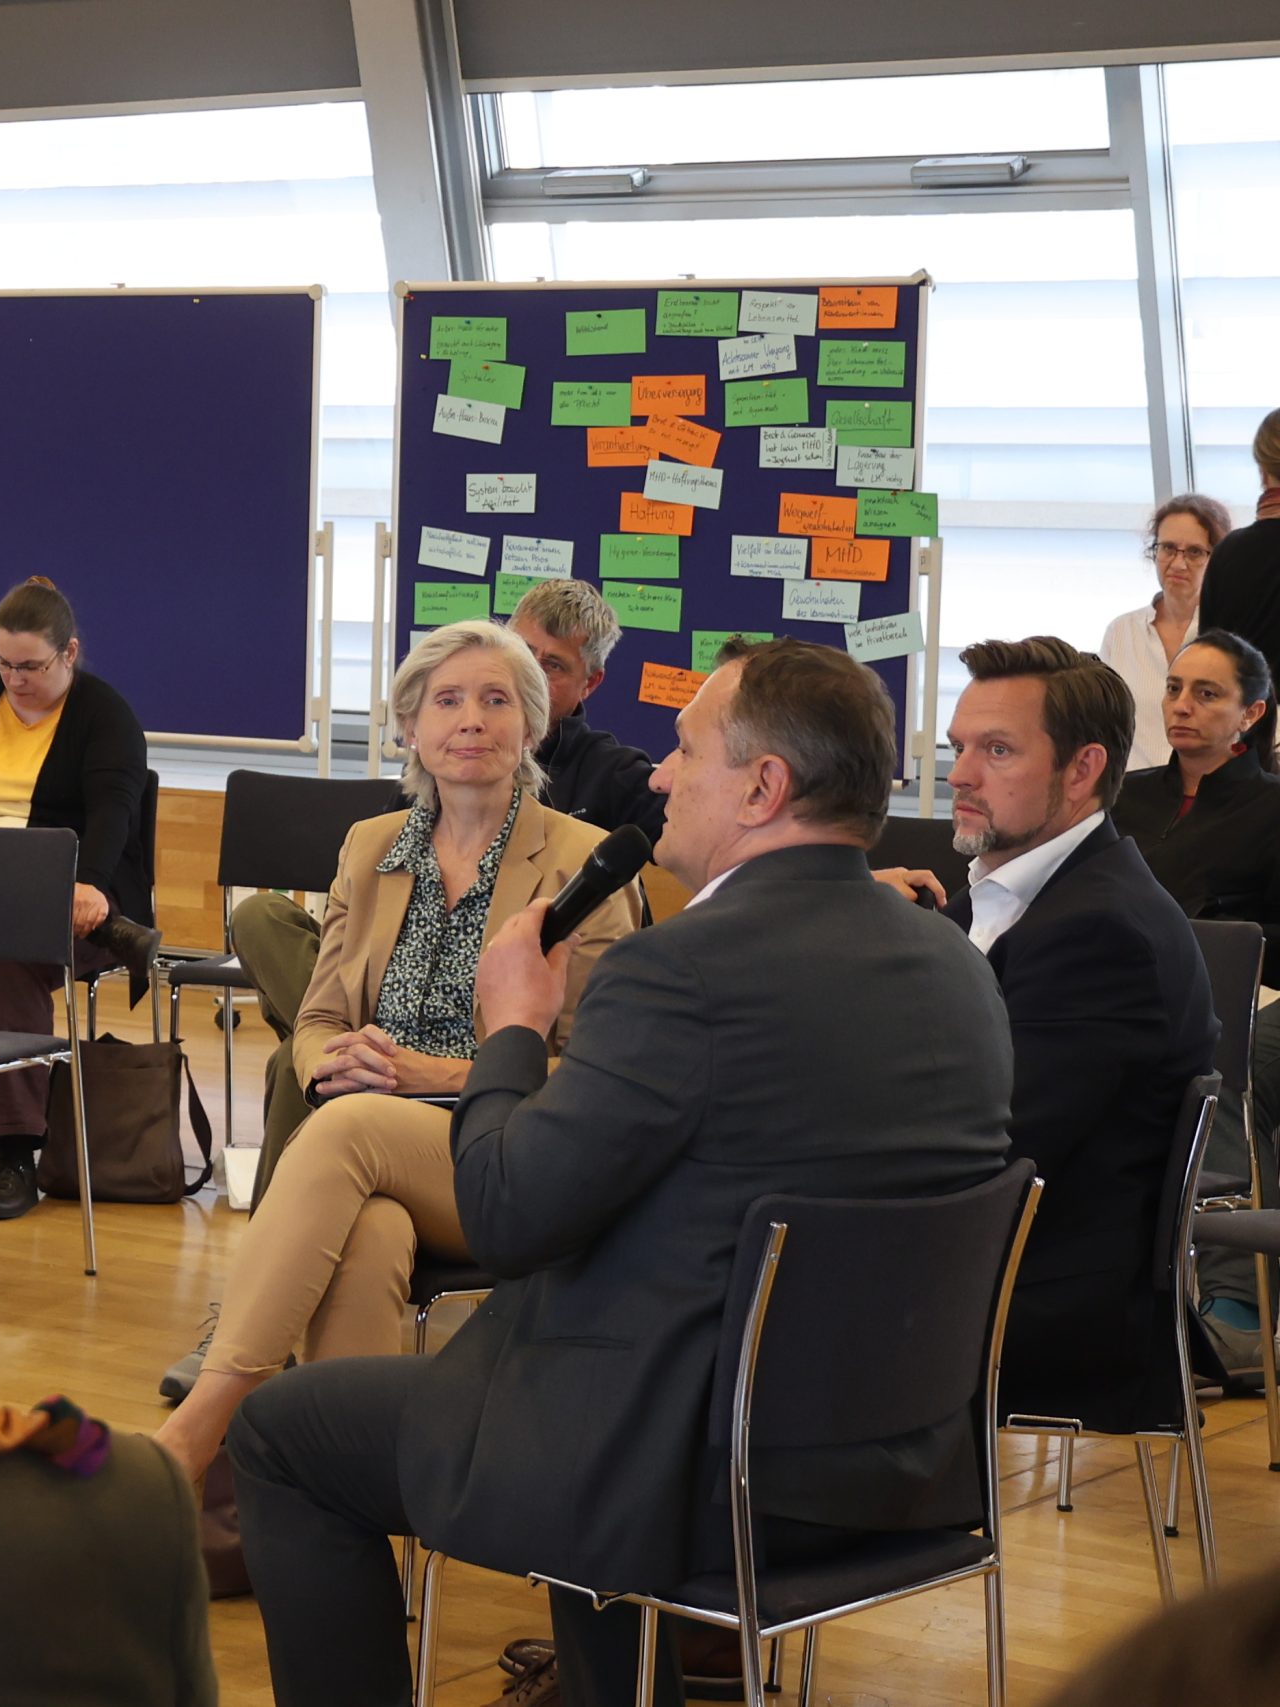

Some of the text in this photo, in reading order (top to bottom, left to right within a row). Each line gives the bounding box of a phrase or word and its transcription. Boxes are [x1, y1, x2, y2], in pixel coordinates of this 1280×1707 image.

[831, 408, 896, 430] Gesellschaft
[629, 502, 676, 530] Haftung
[825, 545, 863, 564] MHD
